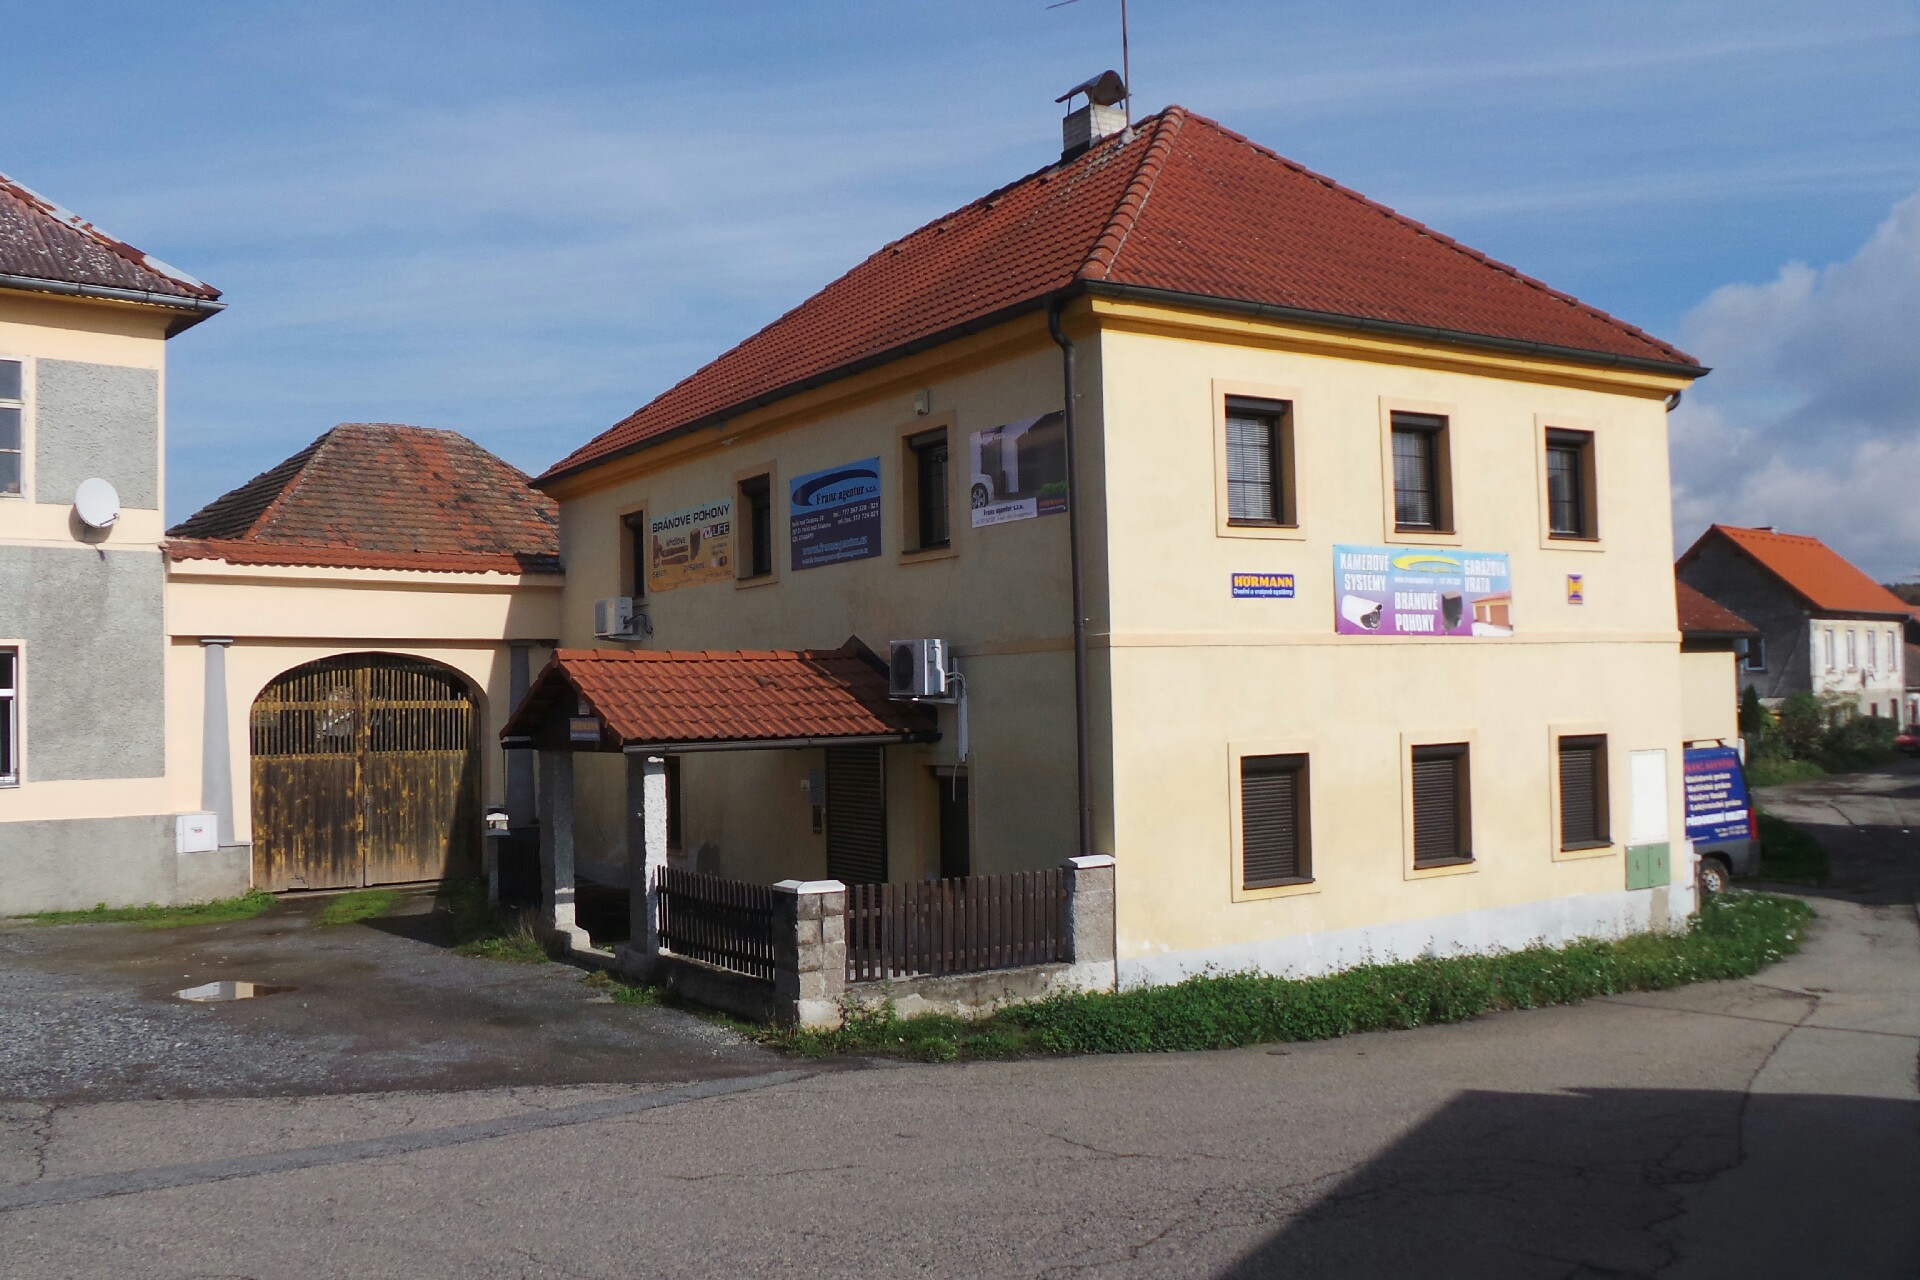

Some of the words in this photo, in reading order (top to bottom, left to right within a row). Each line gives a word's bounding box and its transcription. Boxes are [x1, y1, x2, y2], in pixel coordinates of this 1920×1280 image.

[816, 492, 836, 505] Franz
[838, 485, 865, 502] agentur
[652, 513, 691, 533] BRÁNOVÉ
[693, 503, 730, 524] POHONY
[1340, 552, 1389, 571] KAMEROVÉ
[1234, 575, 1293, 587] HÖRMANN
[1344, 572, 1386, 592] SYSTÉMY
[1464, 576, 1490, 593] VRATA
[1394, 589, 1438, 611] BRÁNOVÉ
[1394, 613, 1434, 632] POHONY
